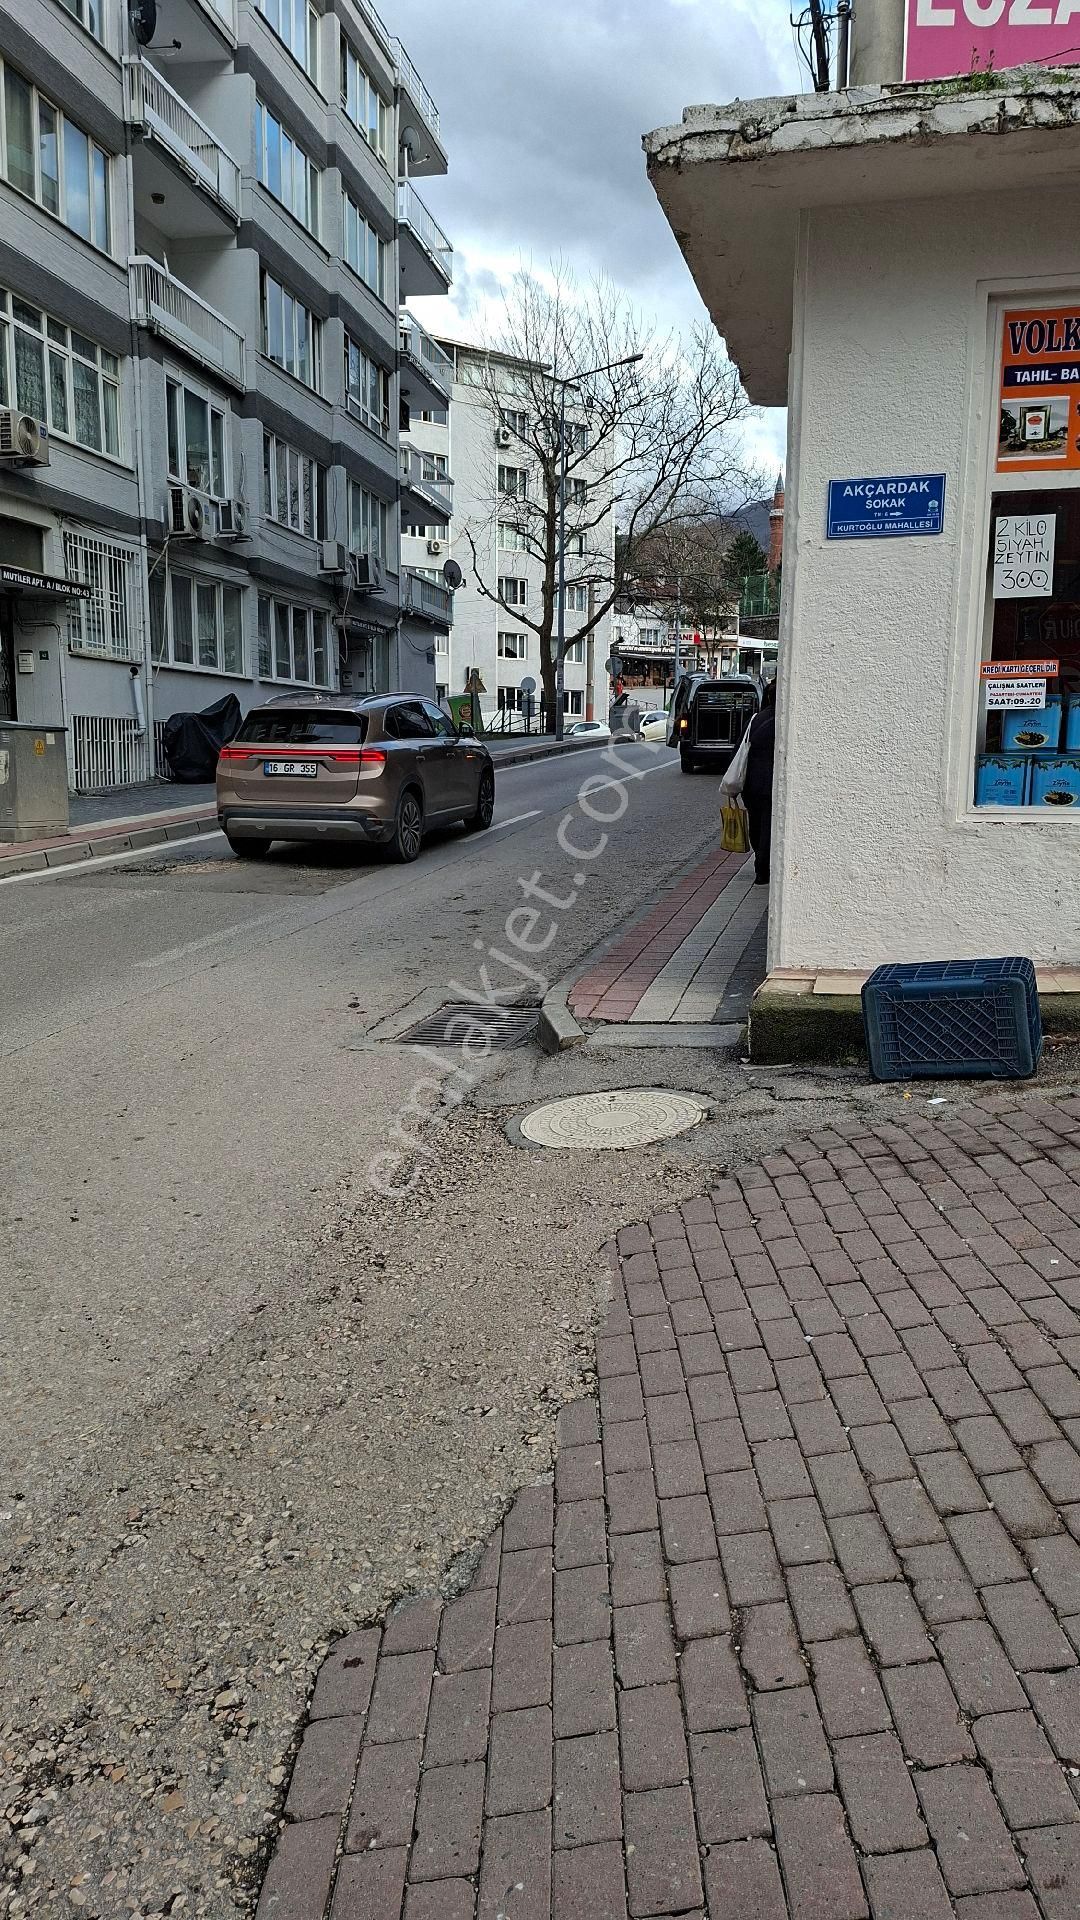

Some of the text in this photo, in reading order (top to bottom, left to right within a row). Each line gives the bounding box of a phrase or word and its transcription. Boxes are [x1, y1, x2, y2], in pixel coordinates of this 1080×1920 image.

[1008, 317, 1080, 355] VOLK
[1060, 368, 1080, 380] BA
[843, 481, 930, 498] AKÇARDAK
[865, 498, 906, 509] SOKAK
[837, 519, 933, 532] KURTOĞLU MAHALLESİ
[997, 519, 1010, 537] 2
[3, 570, 31, 585] MUTİLER
[32, 577, 45, 588] APT.
[55, 583, 71, 593] BLOK
[1001, 569, 1049, 589] 300
[667, 633, 693, 641] CZANE
[269, 763, 316, 773] 16 GR 355
